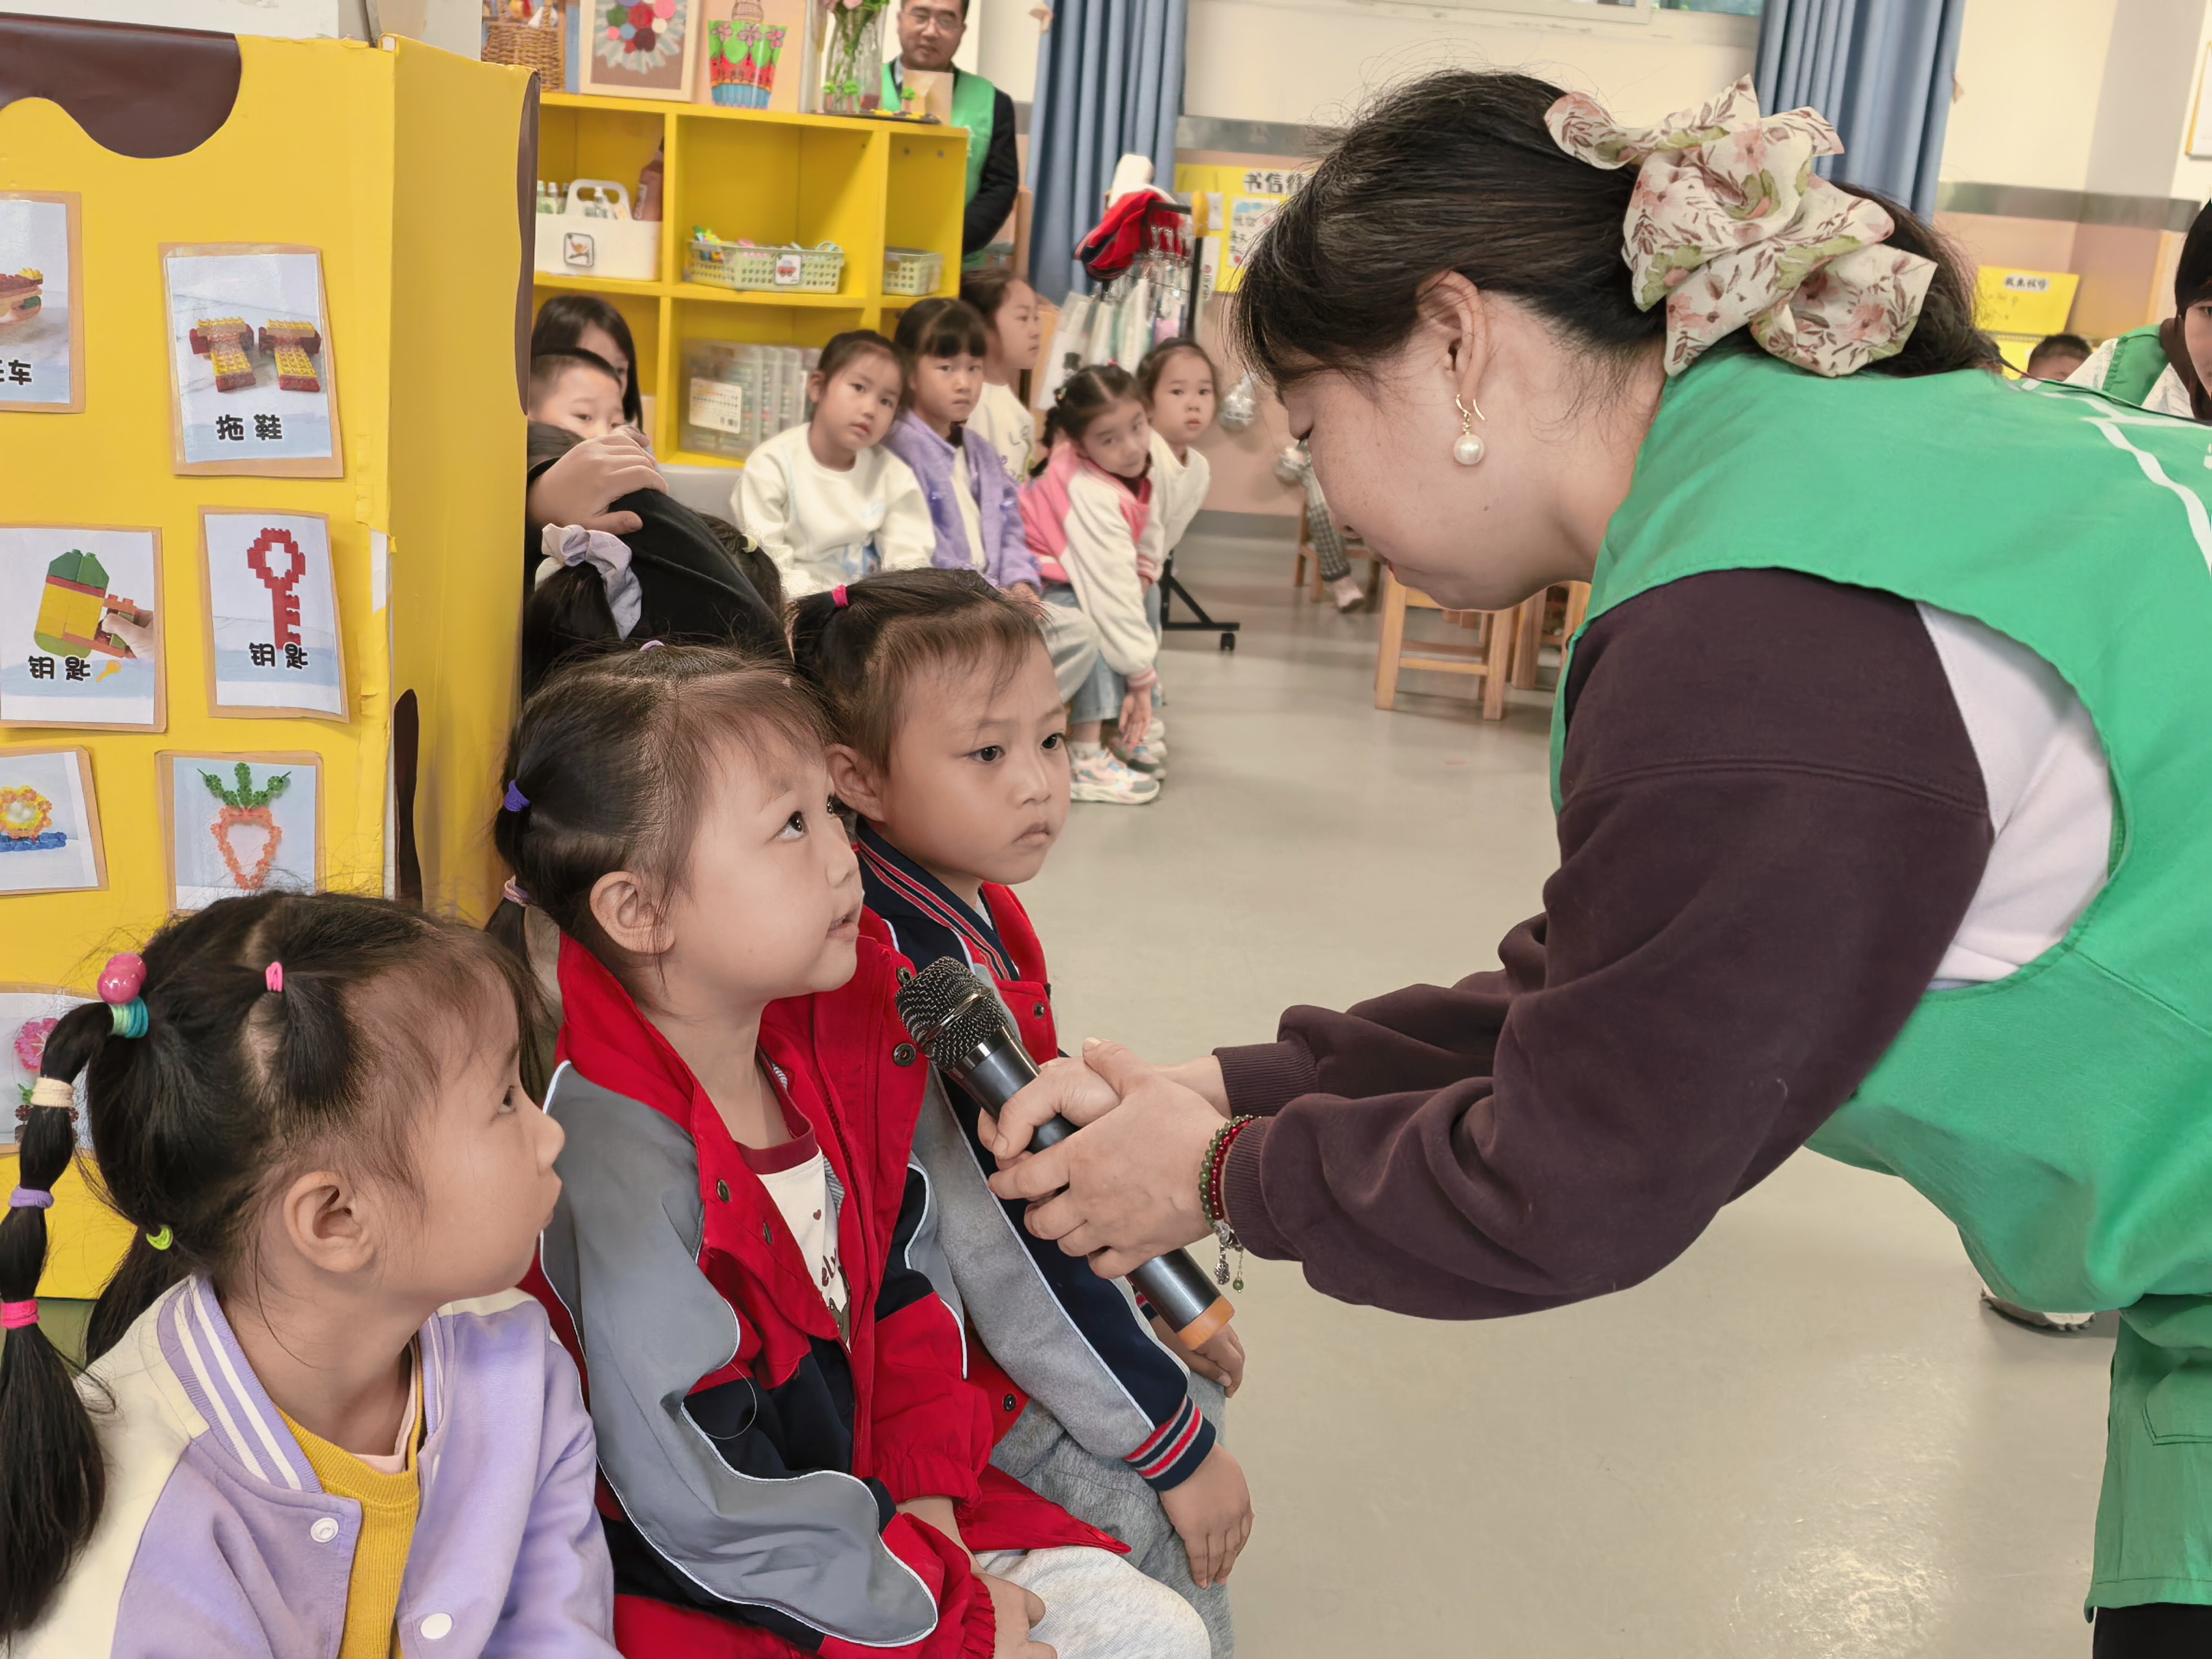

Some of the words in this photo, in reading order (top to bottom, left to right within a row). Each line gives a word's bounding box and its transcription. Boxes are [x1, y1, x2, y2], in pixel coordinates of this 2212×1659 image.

[0, 359, 32, 385] 车
[216, 414, 282, 441] 拖鞋
[28, 656, 91, 681] 钥匙
[248, 642, 308, 669] 钥匙
